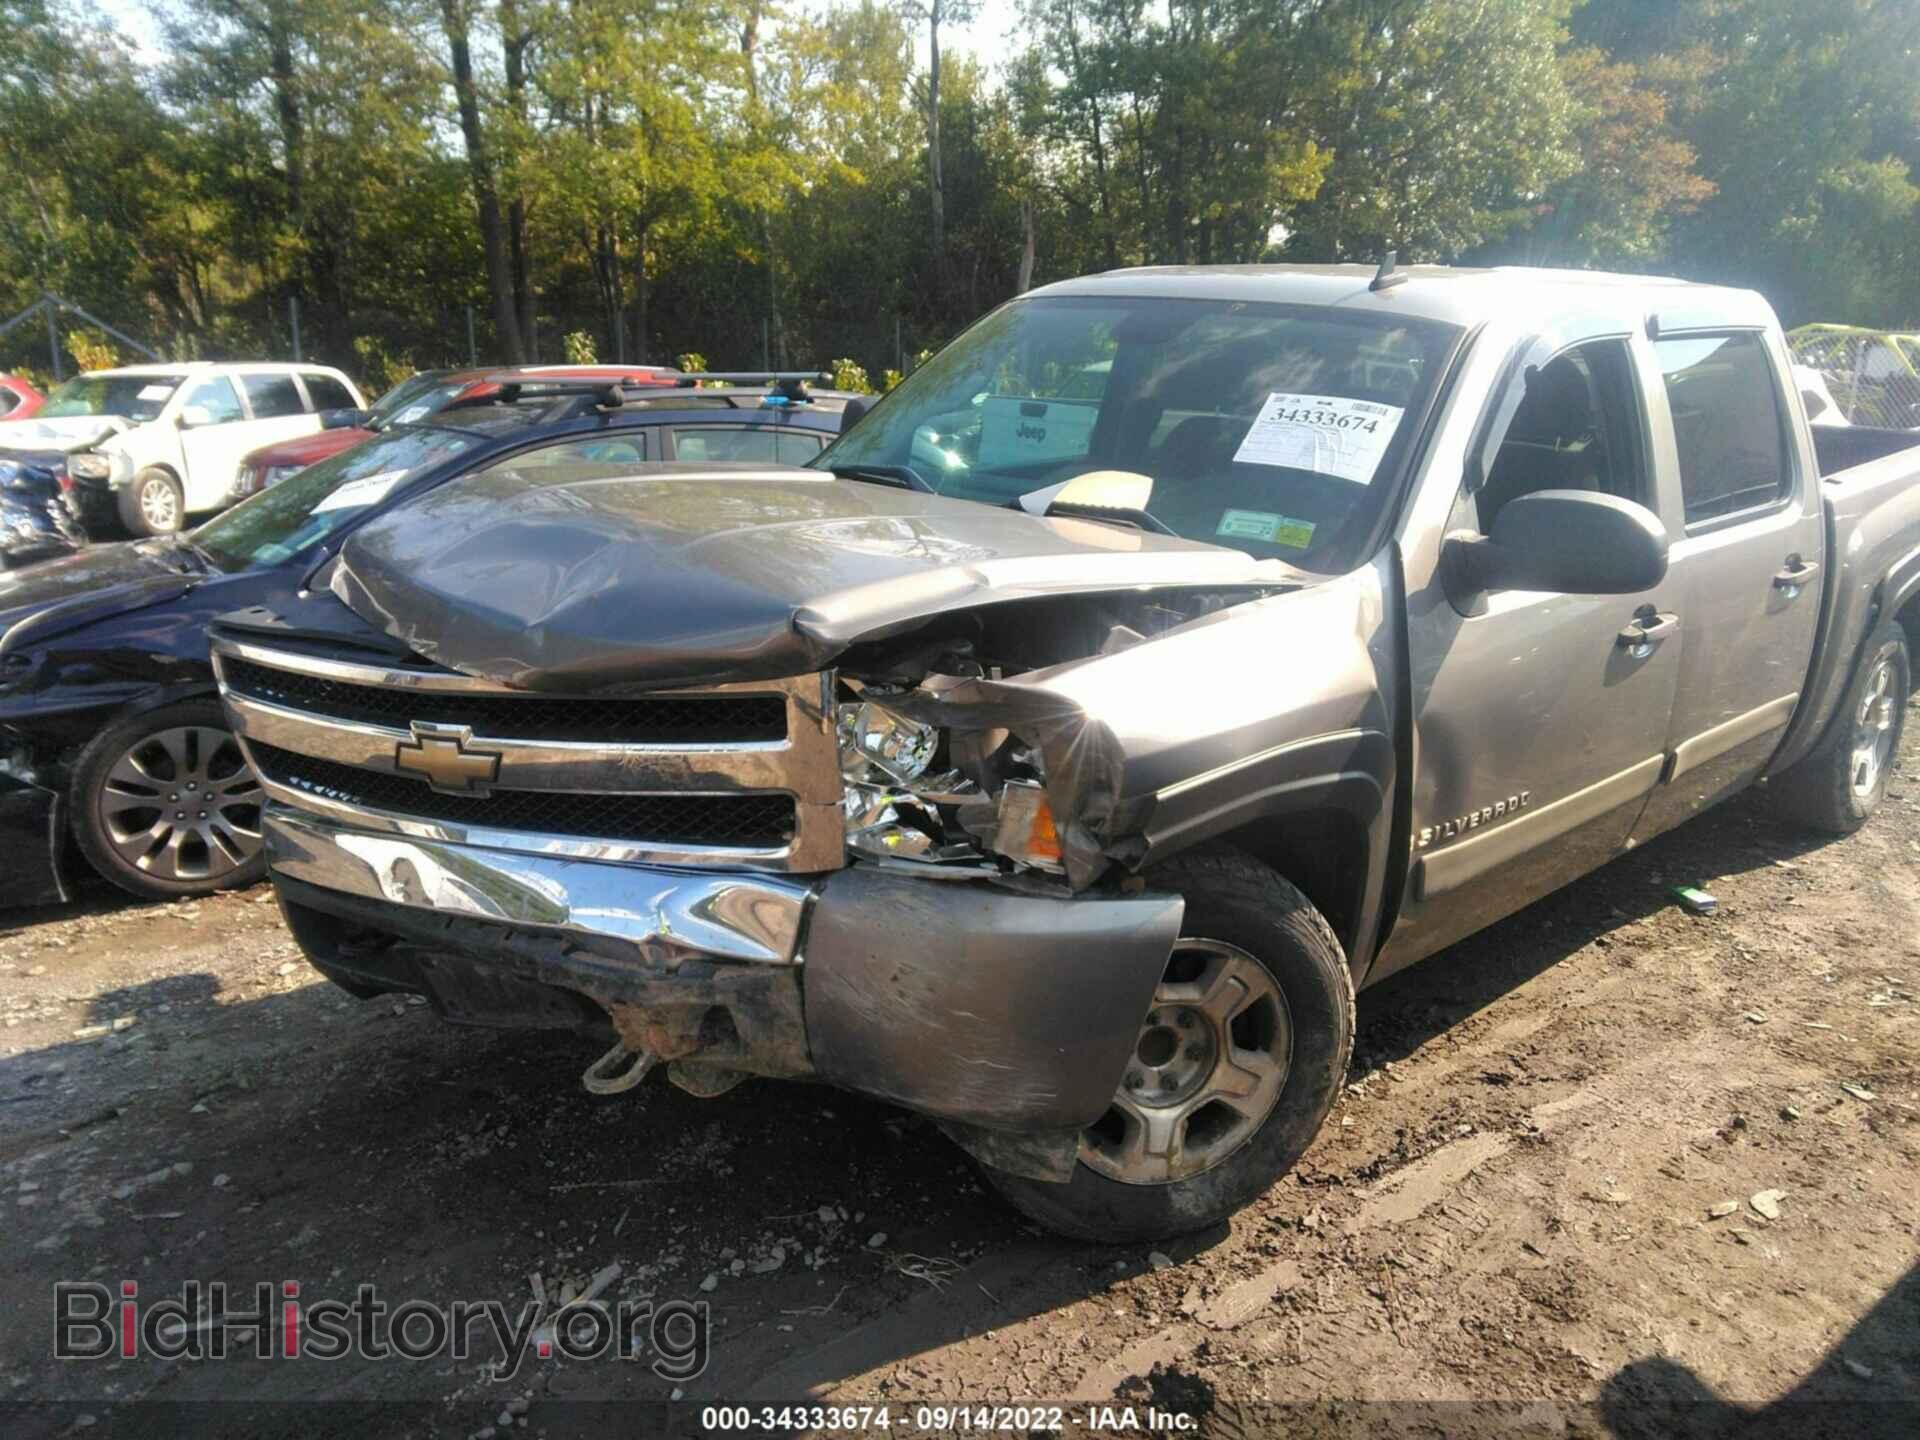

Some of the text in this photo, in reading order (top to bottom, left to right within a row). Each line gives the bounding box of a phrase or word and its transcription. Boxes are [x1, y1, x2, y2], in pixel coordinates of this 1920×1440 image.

[1016, 423, 1047, 443] Jeep
[1269, 407, 1380, 434] 34333674
[1418, 790, 1532, 847] SILVERADO
